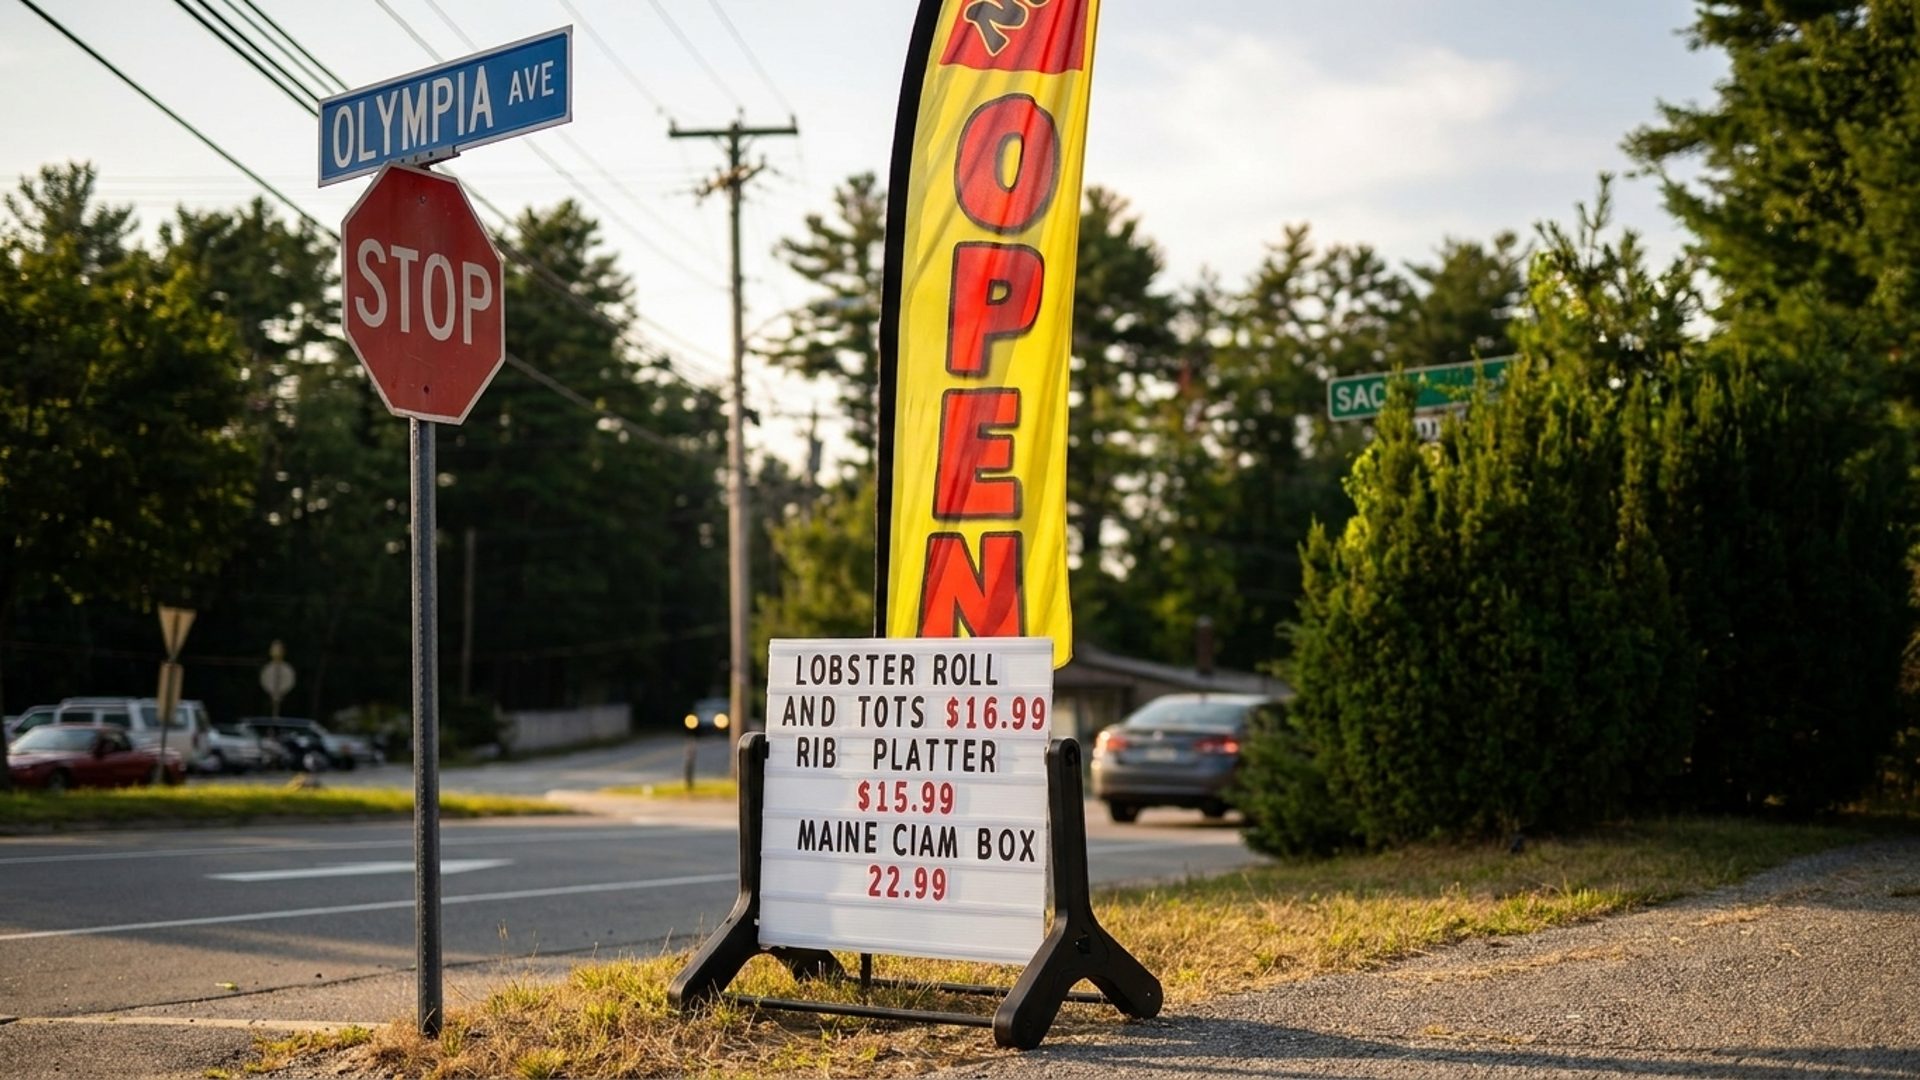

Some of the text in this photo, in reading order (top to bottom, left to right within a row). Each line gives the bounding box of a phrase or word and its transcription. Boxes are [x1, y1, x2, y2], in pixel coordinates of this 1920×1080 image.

[333, 60, 555, 169] OLYMPIA AVE
[354, 238, 493, 345] STOP
[916, 92, 1062, 637] OPEN
[796, 654, 998, 685] LOBSTER ROLL
[782, 696, 1045, 730] AND TOTS $16.99
[796, 737, 996, 772] RIB PLATTER
[858, 781, 954, 814] $15.99
[798, 820, 877, 853] MAINE
[977, 828, 1035, 862] BOX
[868, 865, 947, 900] 22.99
